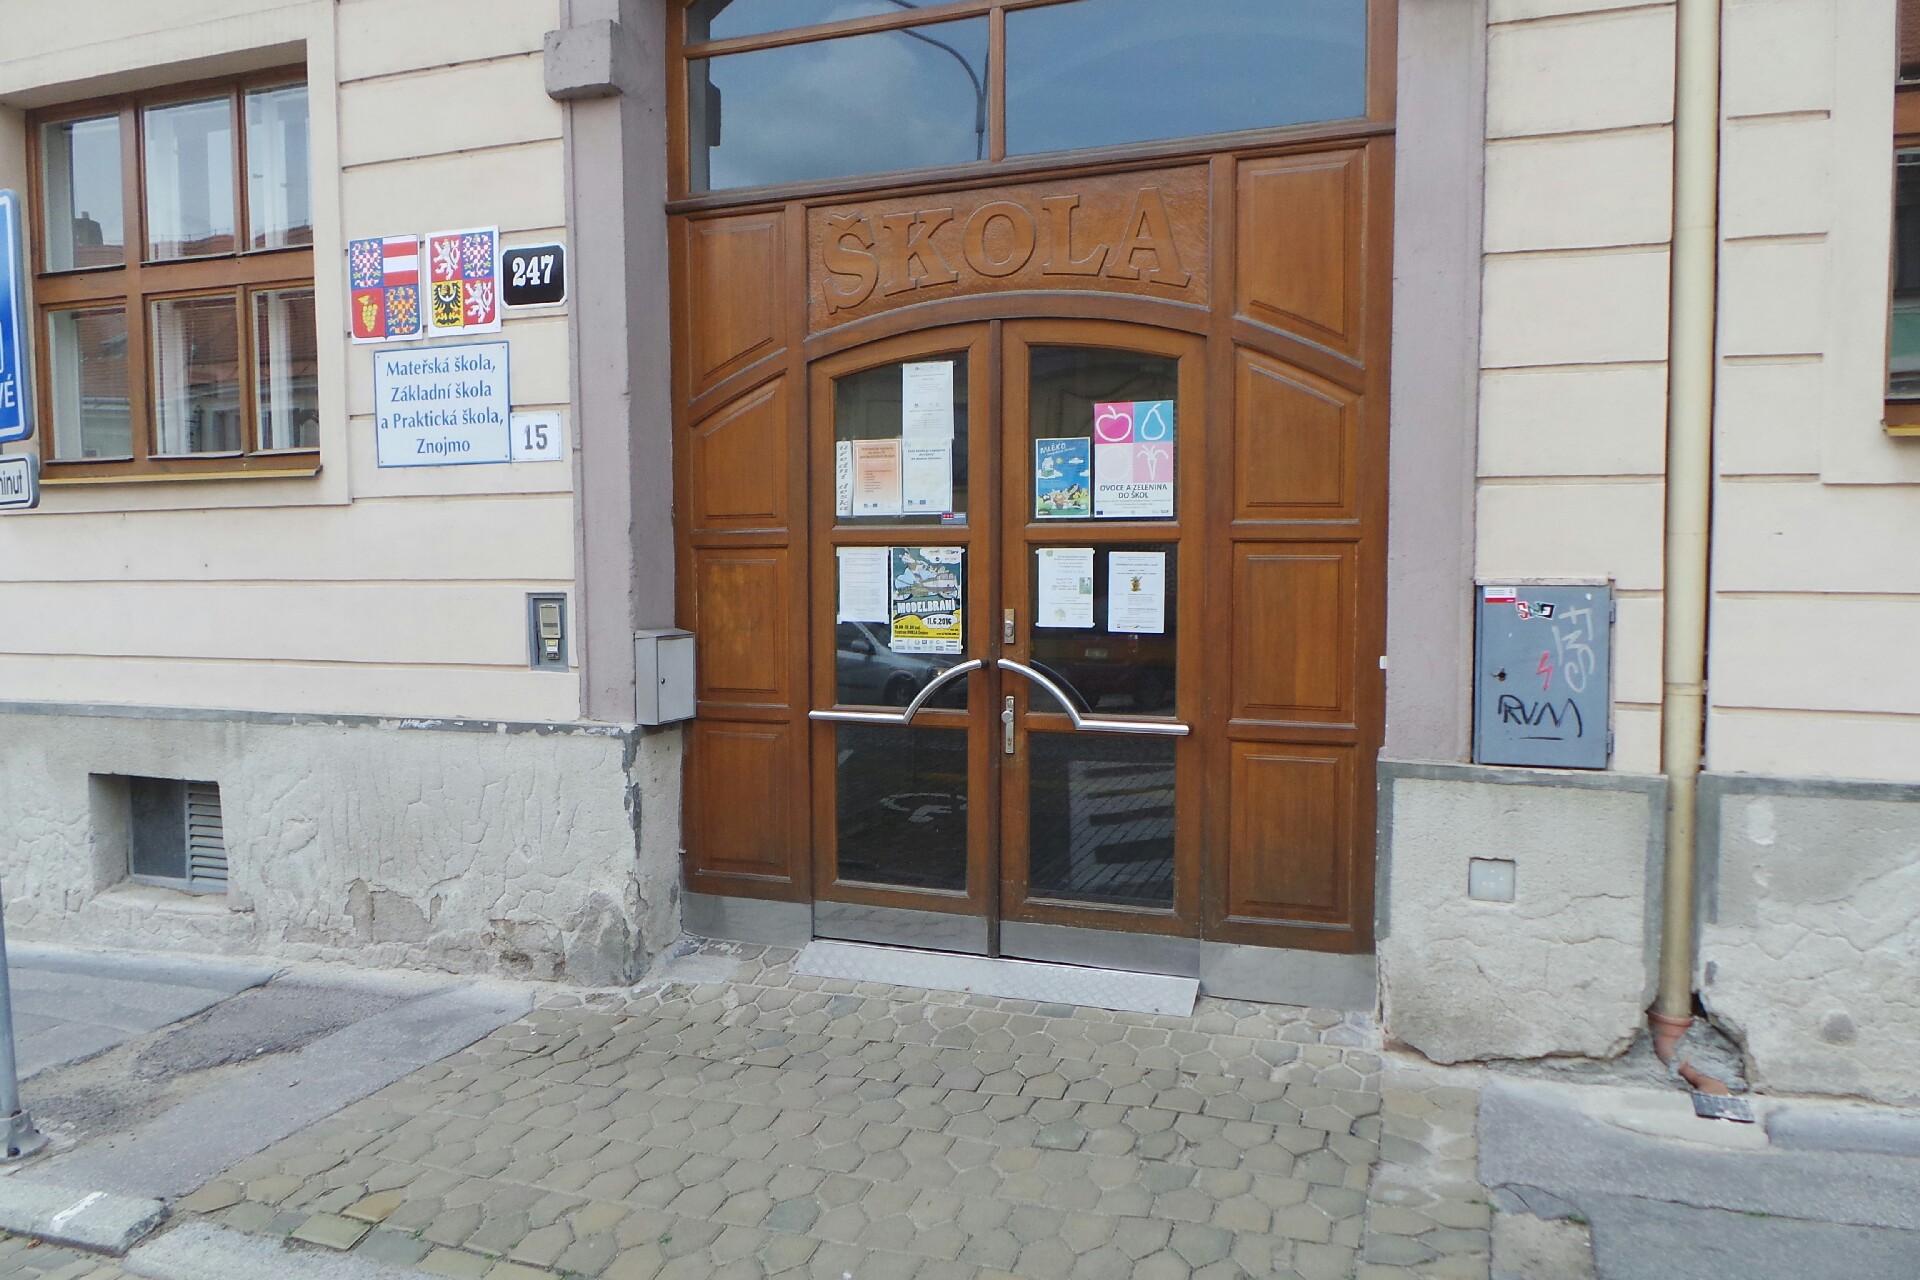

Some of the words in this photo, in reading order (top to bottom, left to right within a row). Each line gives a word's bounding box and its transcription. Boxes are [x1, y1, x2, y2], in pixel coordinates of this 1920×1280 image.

[822, 187, 1191, 314] ŠKOLA
[512, 254, 554, 286] 247
[386, 357, 450, 377] Mateřská
[454, 353, 496, 374] škola,
[391, 383, 452, 402] Základní
[455, 380, 492, 399] škola
[381, 418, 389, 429] a
[393, 409, 457, 429] Praktická
[462, 407, 504, 427] škola,
[416, 436, 470, 457] Znojmo
[524, 424, 548, 450] 15
